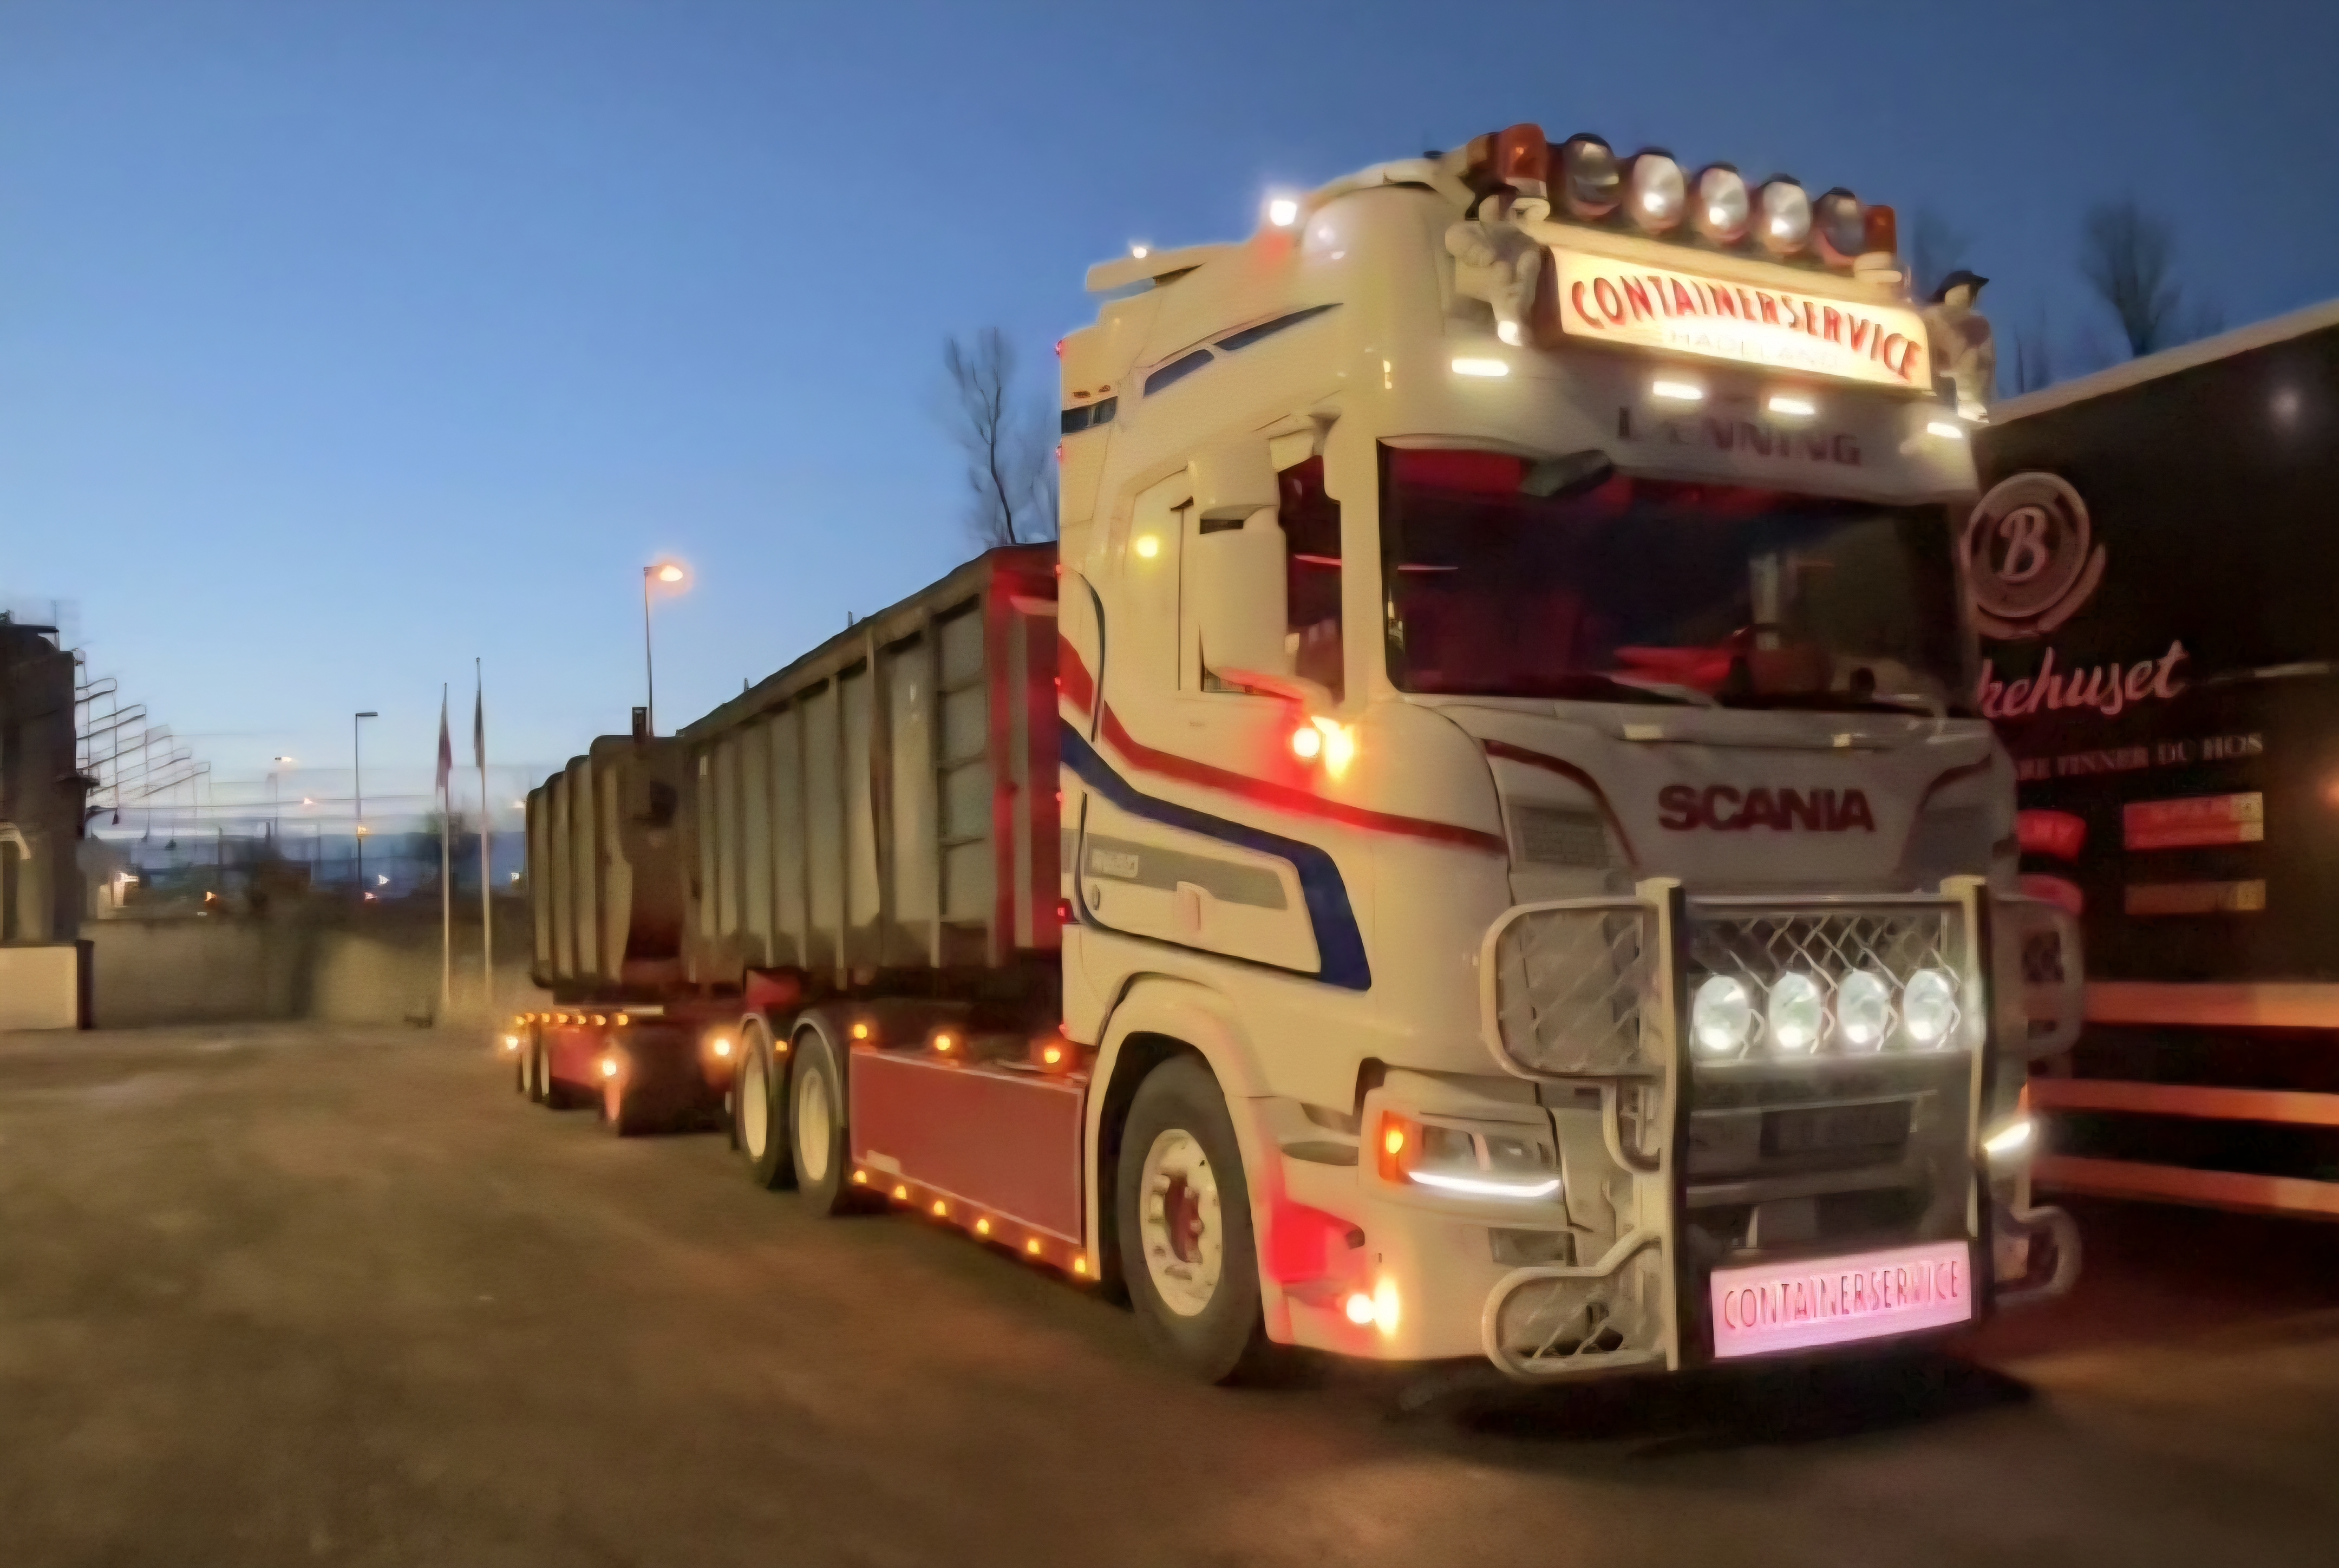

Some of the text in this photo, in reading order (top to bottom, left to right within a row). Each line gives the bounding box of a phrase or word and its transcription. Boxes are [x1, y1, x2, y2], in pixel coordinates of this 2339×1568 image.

[1571, 275, 1922, 381] CONTAINERSERVICE
[1658, 784, 1876, 833] SCANIA
[1724, 1260, 1958, 1329] CONTAINERSERVICE
